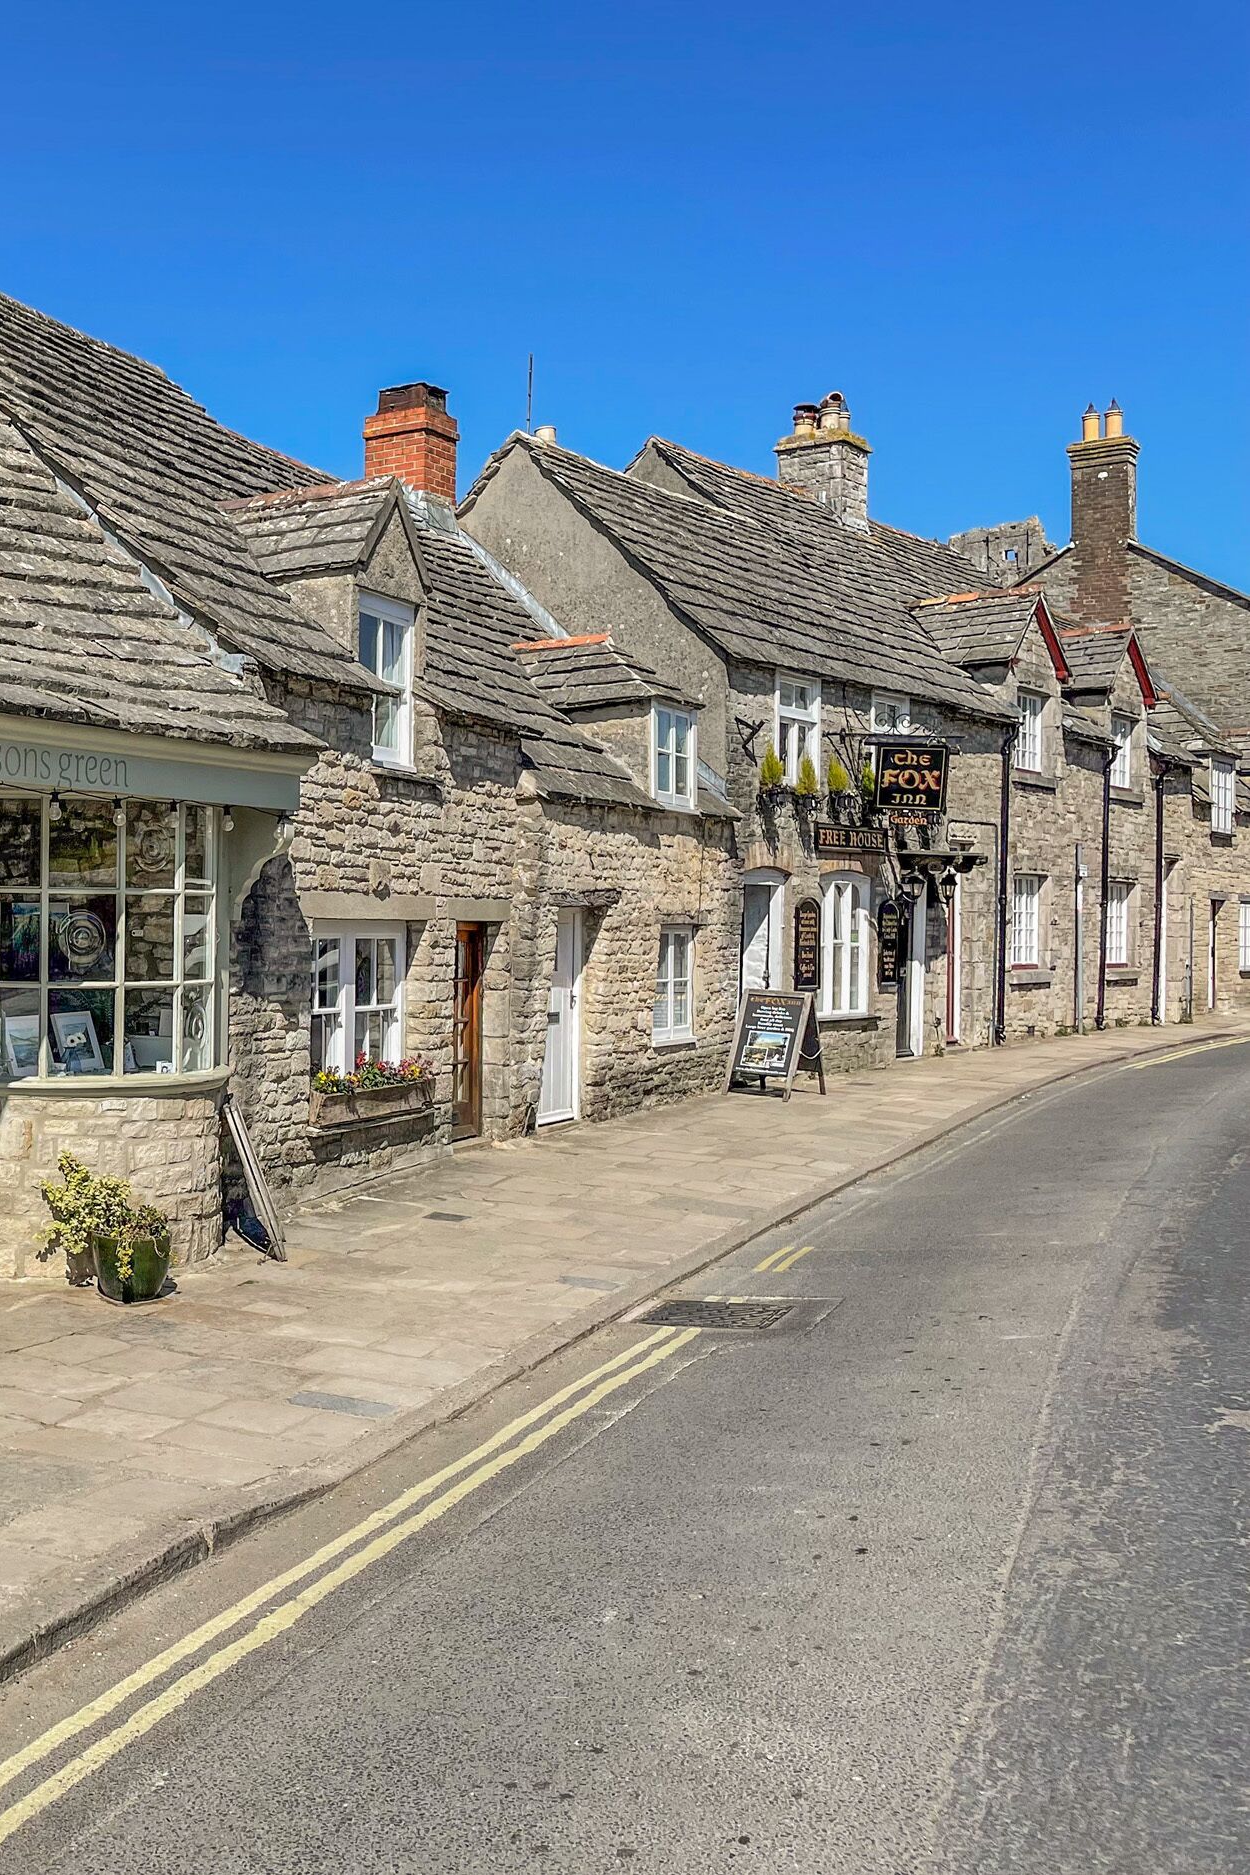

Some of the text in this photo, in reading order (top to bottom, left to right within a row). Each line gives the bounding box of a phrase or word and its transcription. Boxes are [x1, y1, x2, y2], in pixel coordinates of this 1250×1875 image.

[57, 752, 129, 787] green
[880, 769, 940, 790] FOX
[890, 814, 928, 826] Garden
[818, 828, 884, 848] FREE HOUSE
